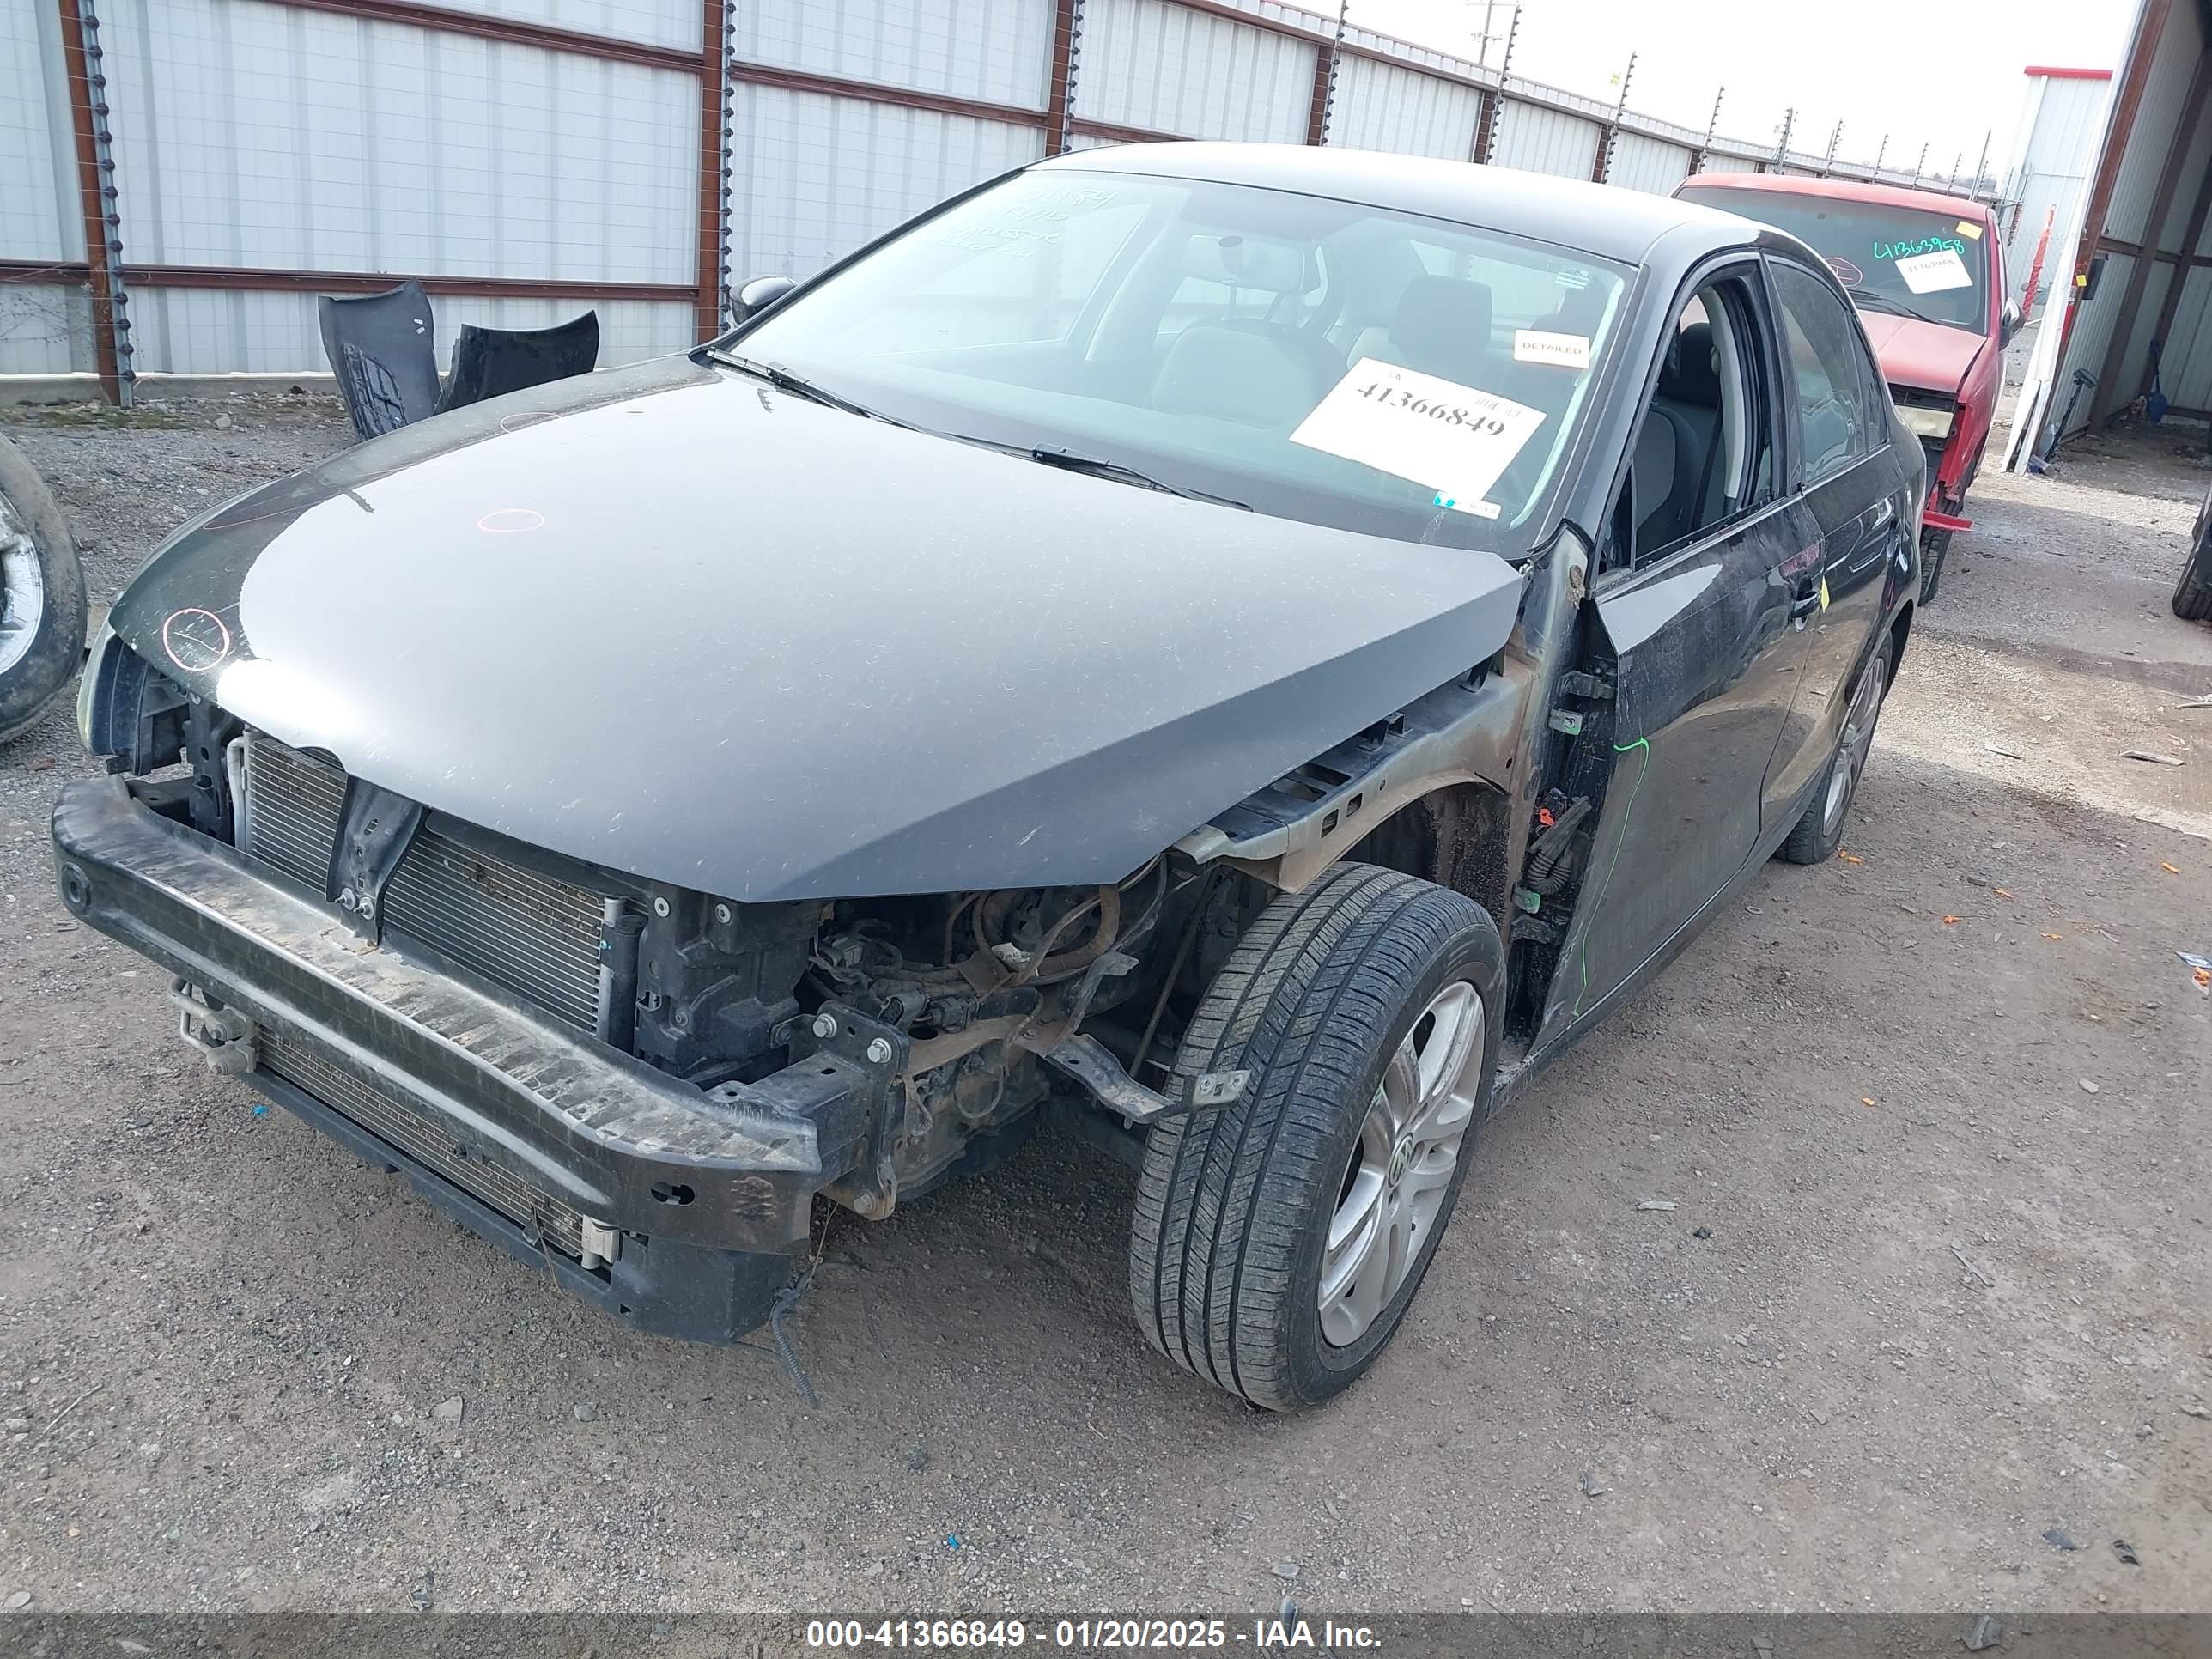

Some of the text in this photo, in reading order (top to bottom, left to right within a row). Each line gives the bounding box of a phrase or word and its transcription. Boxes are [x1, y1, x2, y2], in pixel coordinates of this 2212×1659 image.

[1874, 237, 1965, 259] 41363958
[1522, 342, 1582, 355] DETAILED
[1356, 383, 1505, 436] 41366849
